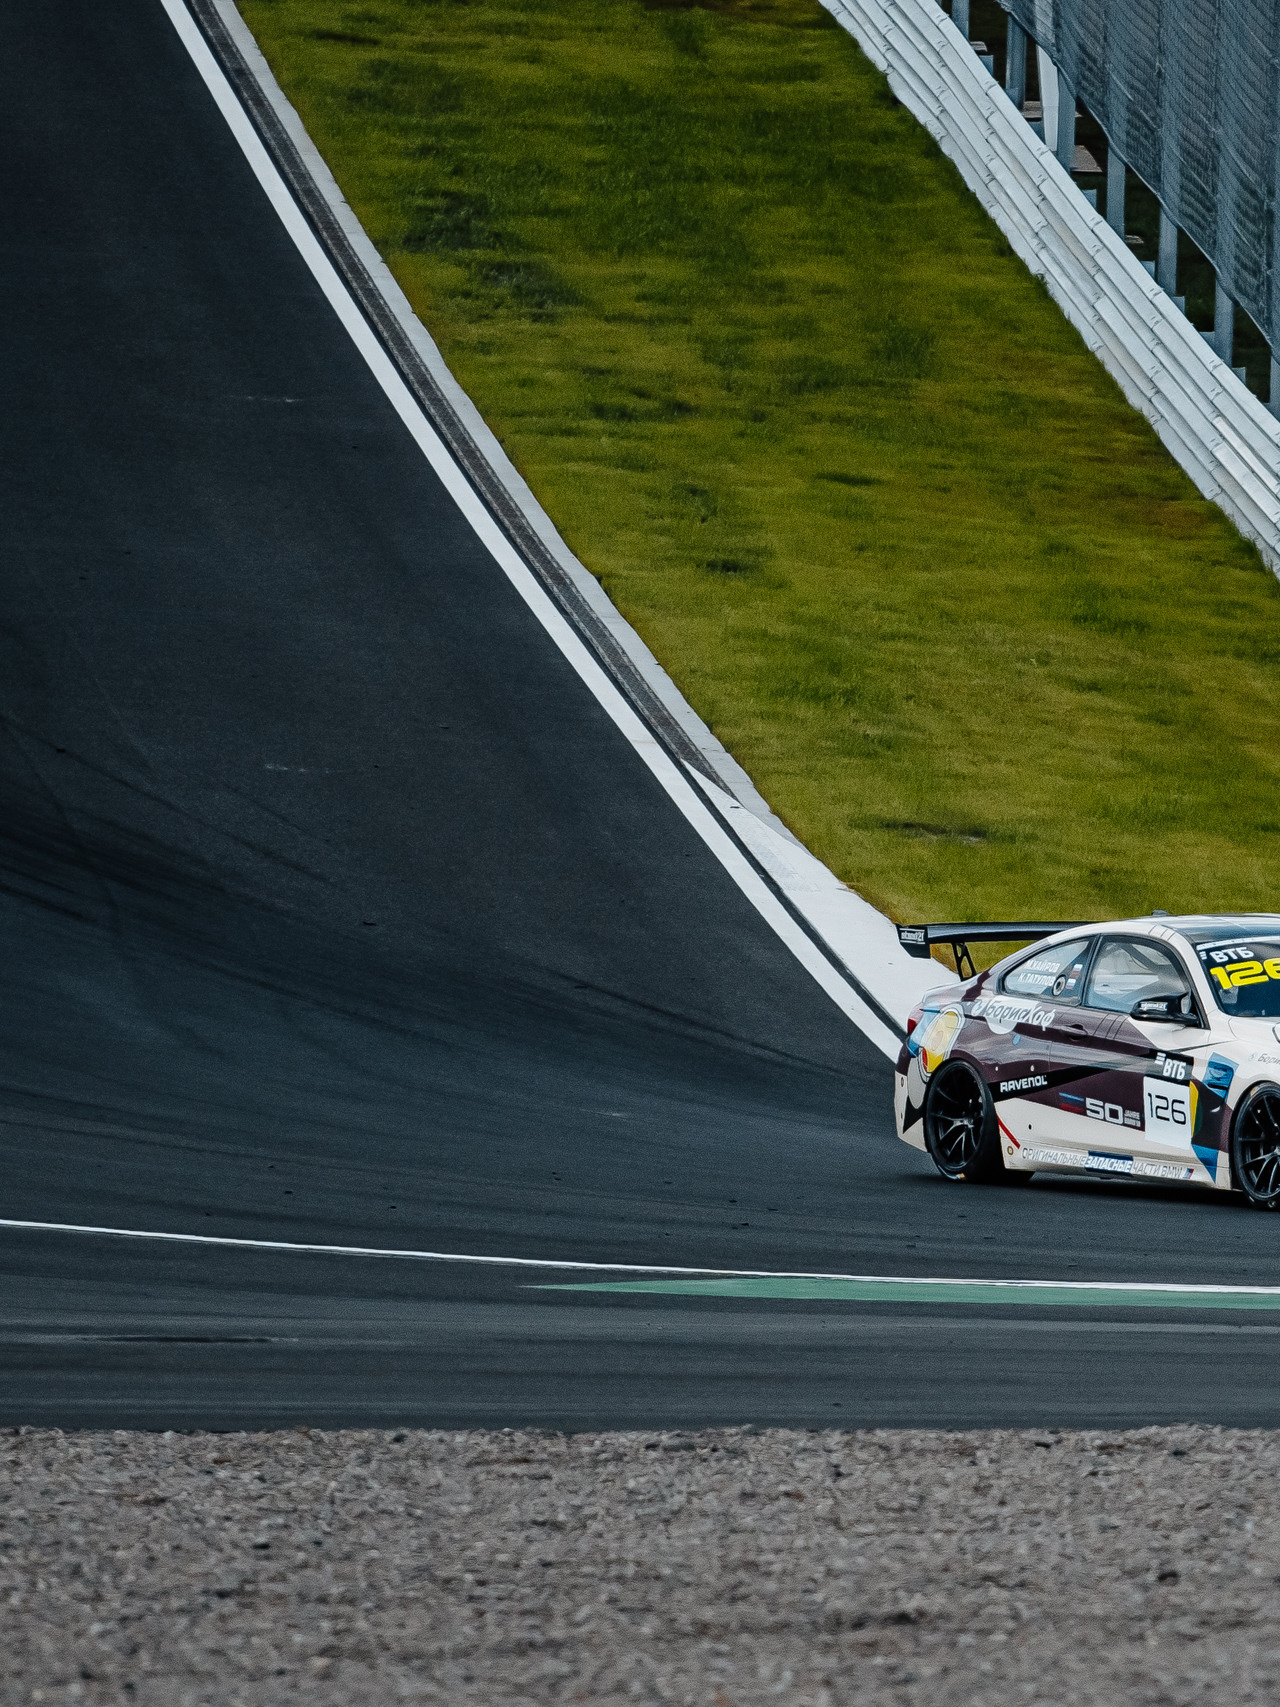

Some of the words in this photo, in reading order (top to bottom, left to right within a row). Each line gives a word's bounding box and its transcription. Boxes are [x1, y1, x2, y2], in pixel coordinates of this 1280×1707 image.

[1210, 946, 1254, 963] ВТБ
[985, 1000, 1056, 1031] БорисХоф
[1162, 1058, 1187, 1080] ВТБ
[1000, 1075, 1048, 1093] RAVENOL
[1085, 1097, 1124, 1125] 50
[1147, 1092, 1187, 1125] 126
[1022, 1147, 1087, 1167] ОРИГИНАЛЬНЫЕ
[1085, 1155, 1133, 1174] ЗАПАСНЫЕ
[1133, 1161, 1161, 1176] ЧАСТИ
[1161, 1165, 1183, 1179] BMW
